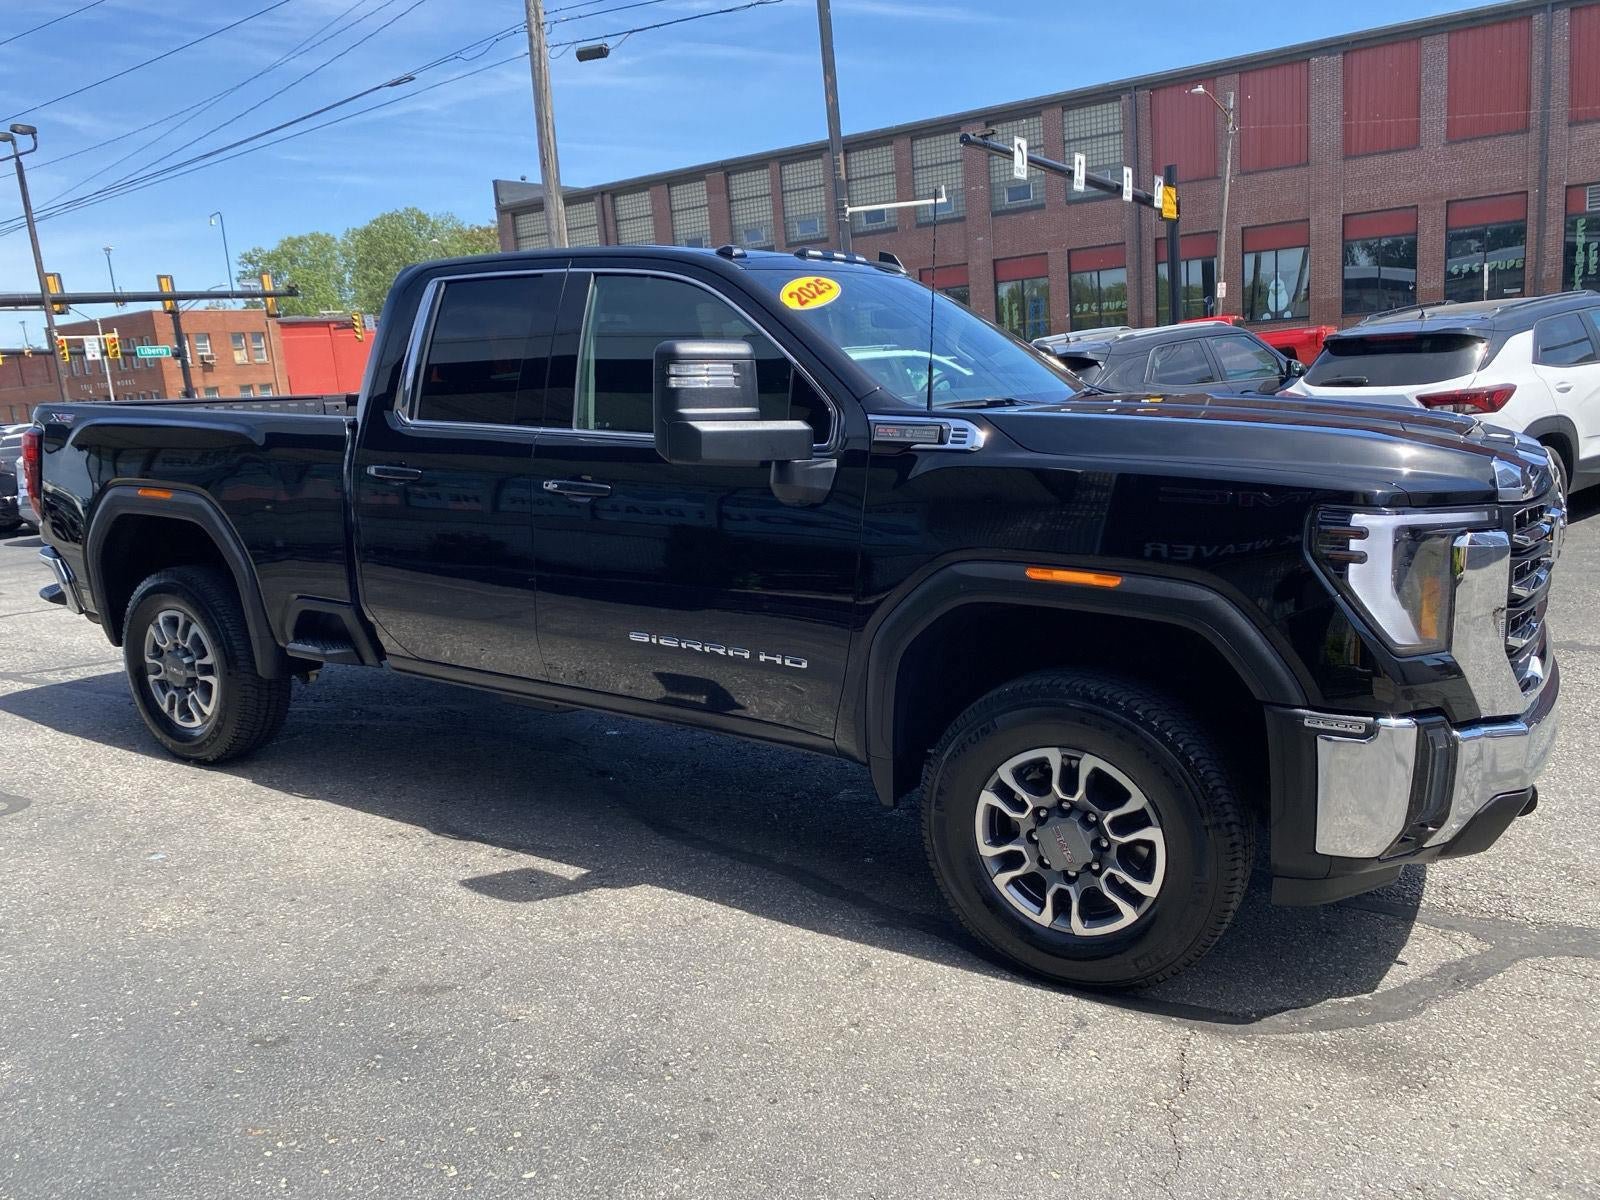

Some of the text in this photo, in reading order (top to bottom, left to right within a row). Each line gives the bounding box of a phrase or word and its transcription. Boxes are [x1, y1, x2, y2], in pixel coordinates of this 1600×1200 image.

[788, 278, 833, 306] 2025
[140, 347, 167, 355] Liberty
[628, 631, 808, 669] SIERRA HD
